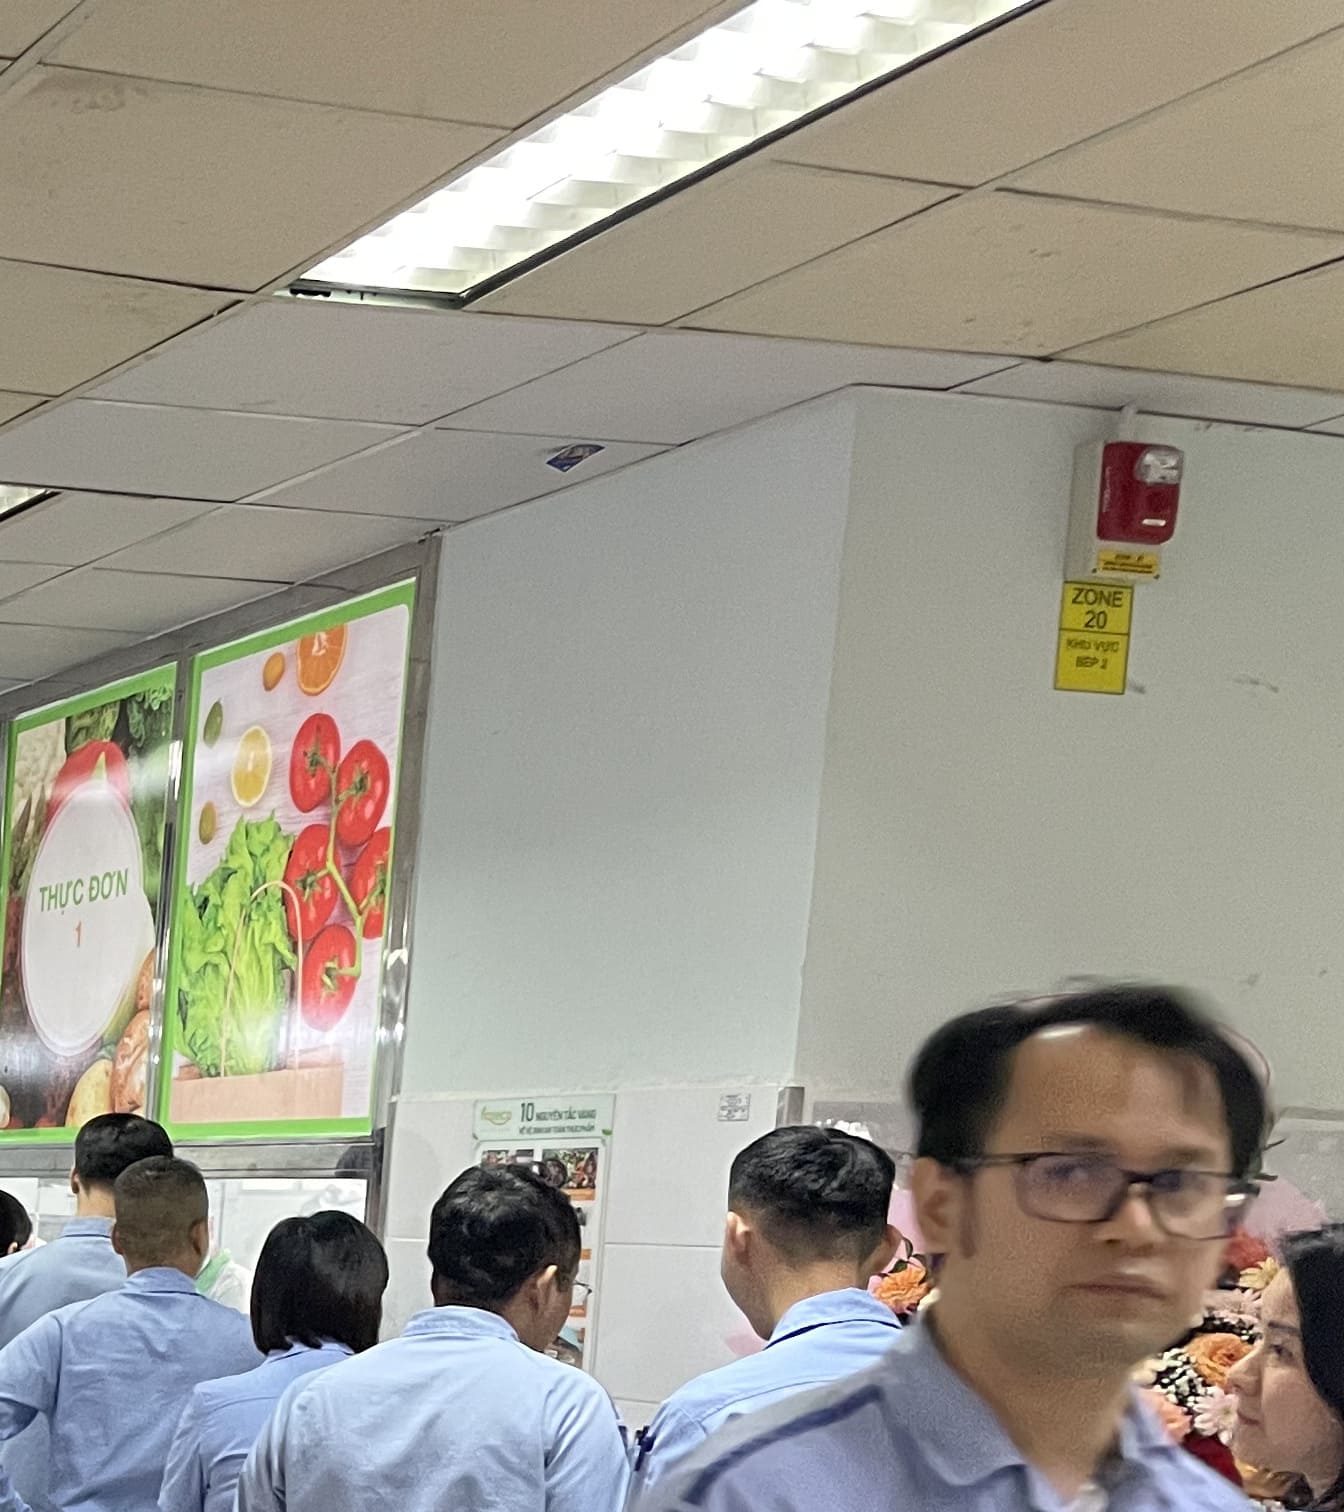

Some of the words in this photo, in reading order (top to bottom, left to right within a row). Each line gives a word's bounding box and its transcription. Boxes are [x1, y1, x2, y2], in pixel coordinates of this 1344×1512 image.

[1071, 587, 1123, 608] ZONE
[1084, 610, 1108, 630] 20
[39, 877, 84, 916] THỰC
[88, 867, 129, 903] ĐƠN
[74, 919, 83, 948] 1
[520, 1102, 535, 1122] 10
